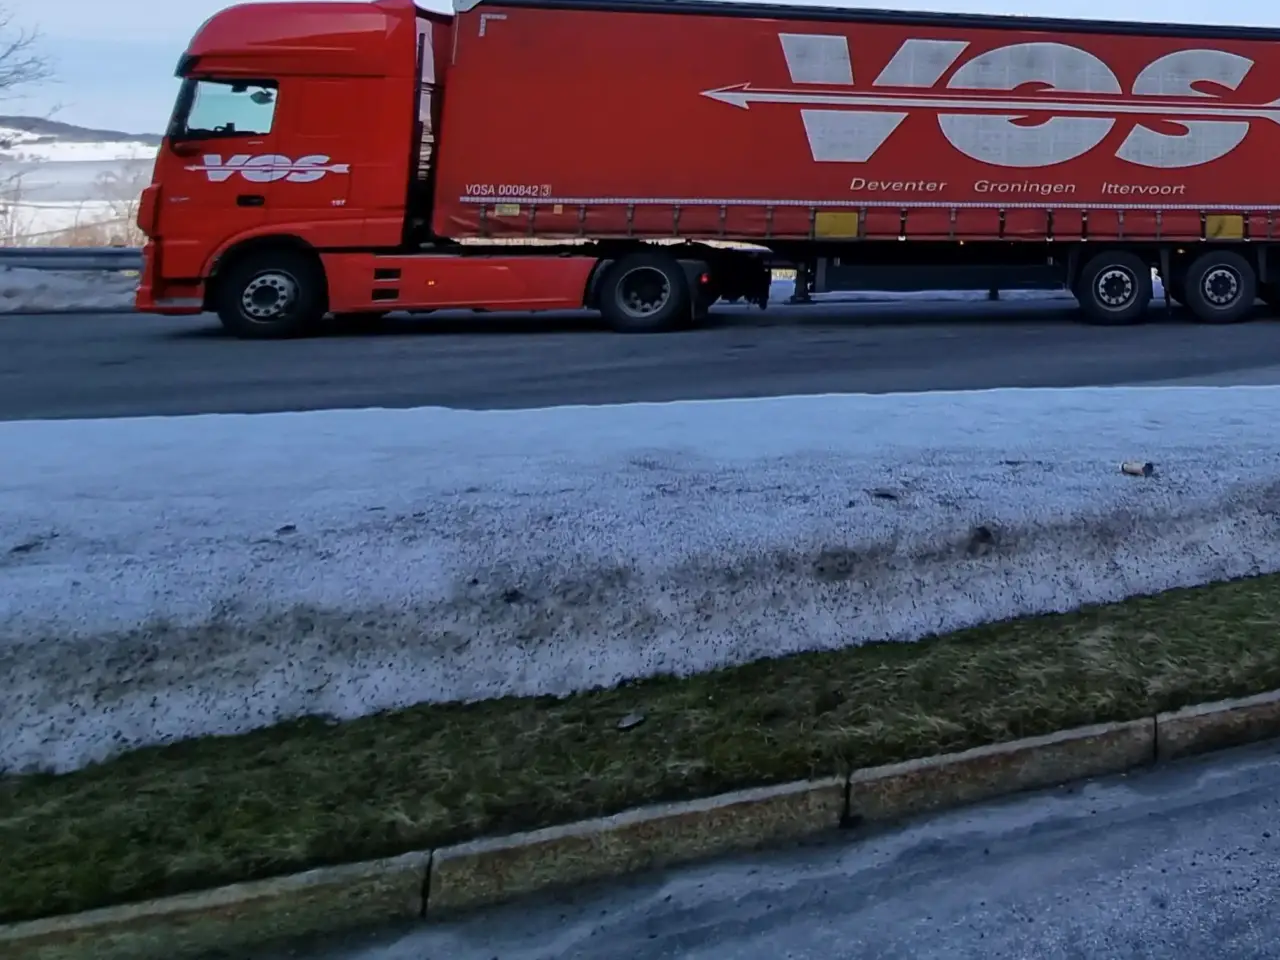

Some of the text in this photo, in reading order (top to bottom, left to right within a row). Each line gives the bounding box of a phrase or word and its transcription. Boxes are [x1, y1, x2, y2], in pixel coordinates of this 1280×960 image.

[778, 33, 1255, 168] VOS
[203, 154, 331, 183] VOS
[465, 183, 496, 196] VOSA
[498, 184, 539, 197] 000842
[849, 177, 1186, 196] Deventer Groningen Ittervoort
